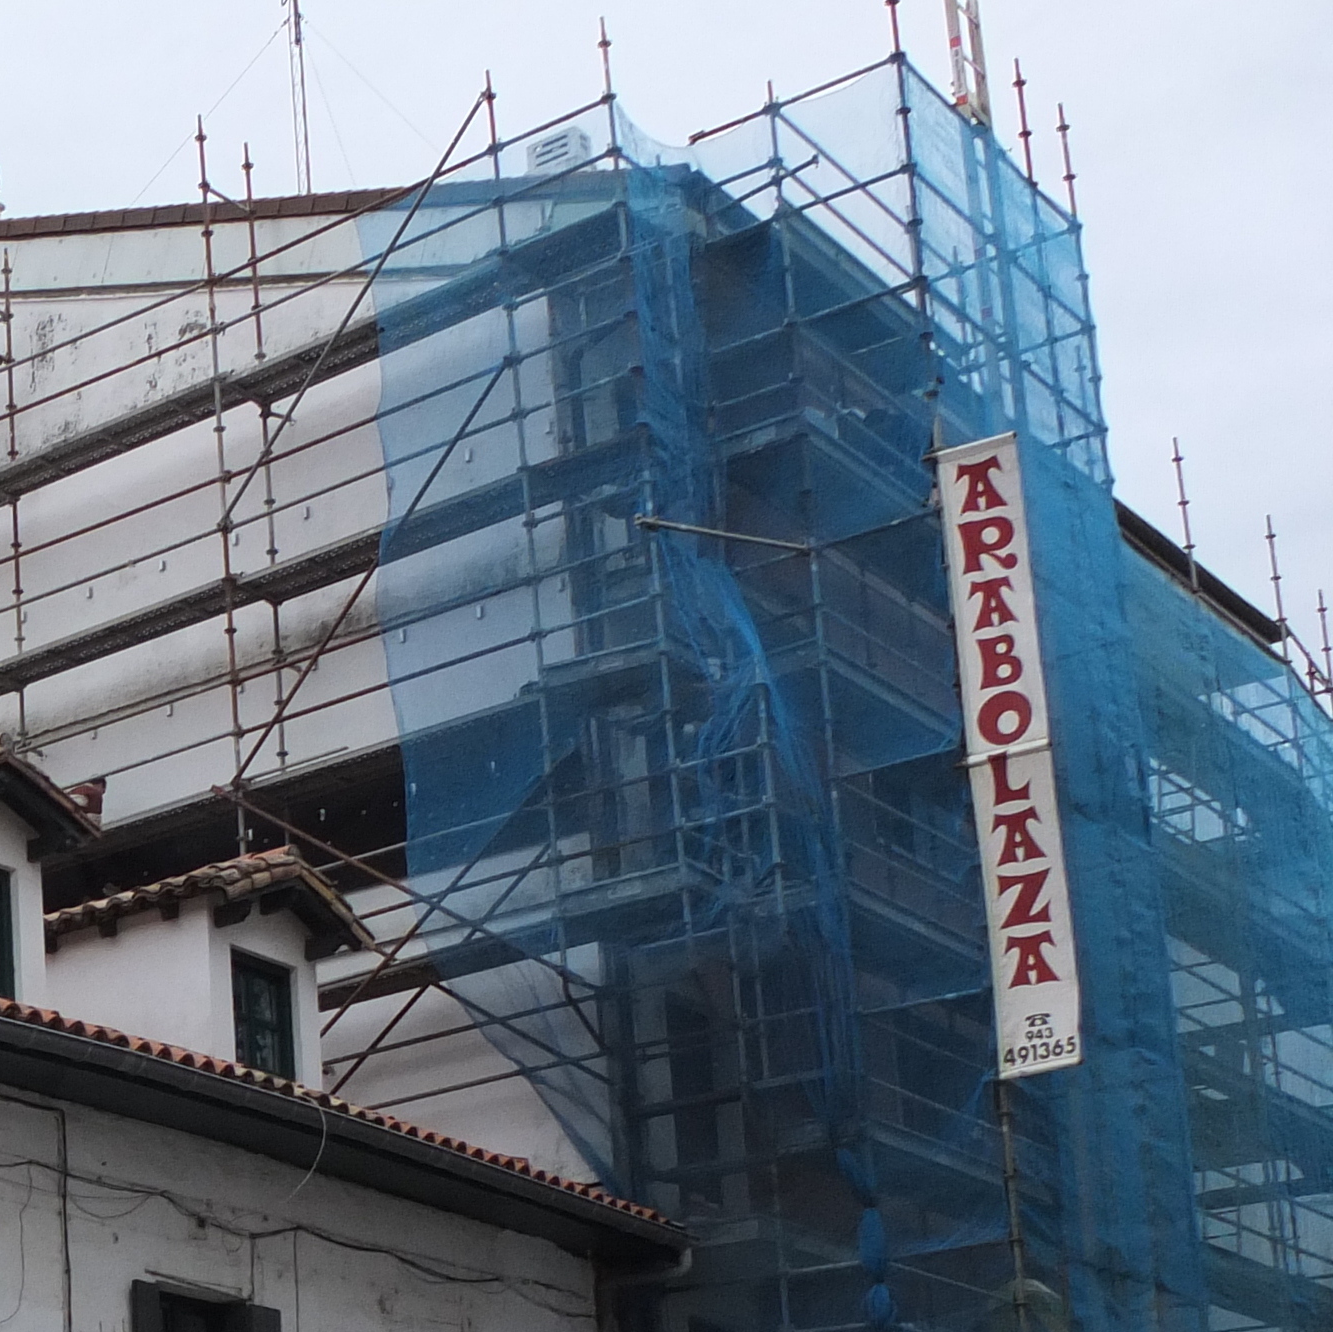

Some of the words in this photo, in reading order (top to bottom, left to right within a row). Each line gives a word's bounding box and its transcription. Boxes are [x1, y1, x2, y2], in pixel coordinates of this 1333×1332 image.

[955, 455, 1062, 990] ARABOLAZA
[1025, 1027, 1053, 1042] 943
[1003, 1036, 1076, 1066] 491365
